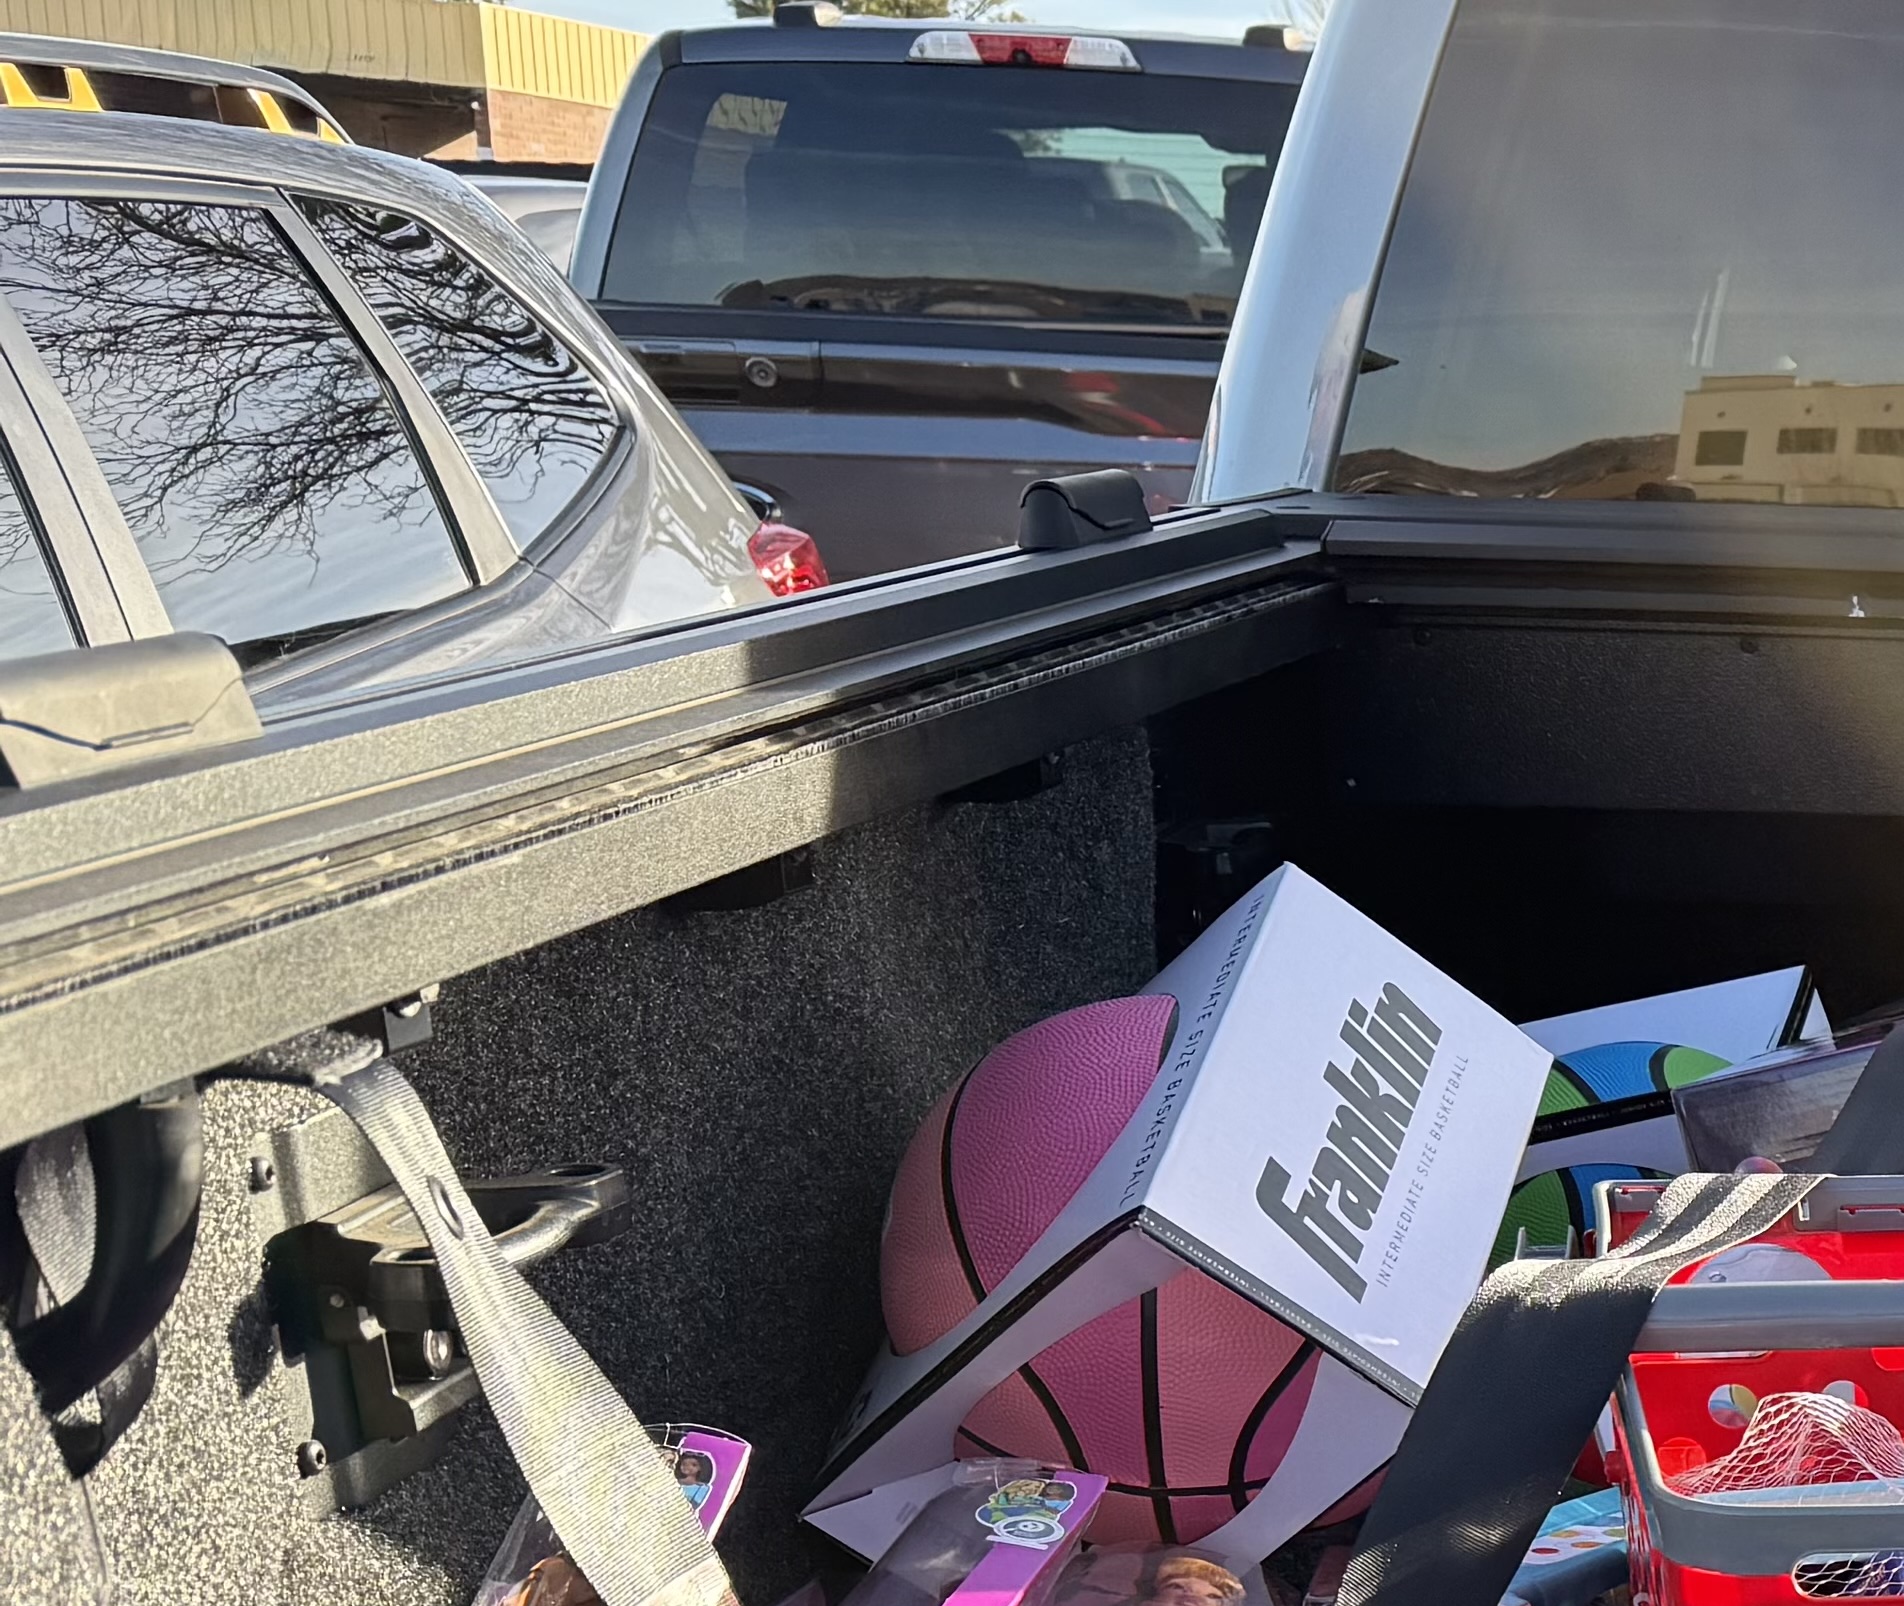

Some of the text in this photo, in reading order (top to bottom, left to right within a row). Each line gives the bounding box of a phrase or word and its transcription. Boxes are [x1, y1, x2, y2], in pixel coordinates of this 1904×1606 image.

[1119, 894, 1266, 1208] INTERMEDIATE SIZE BASKETBALL
[1375, 1055, 1470, 1288] INTERMEDIATE SIZE BASKETBALL
